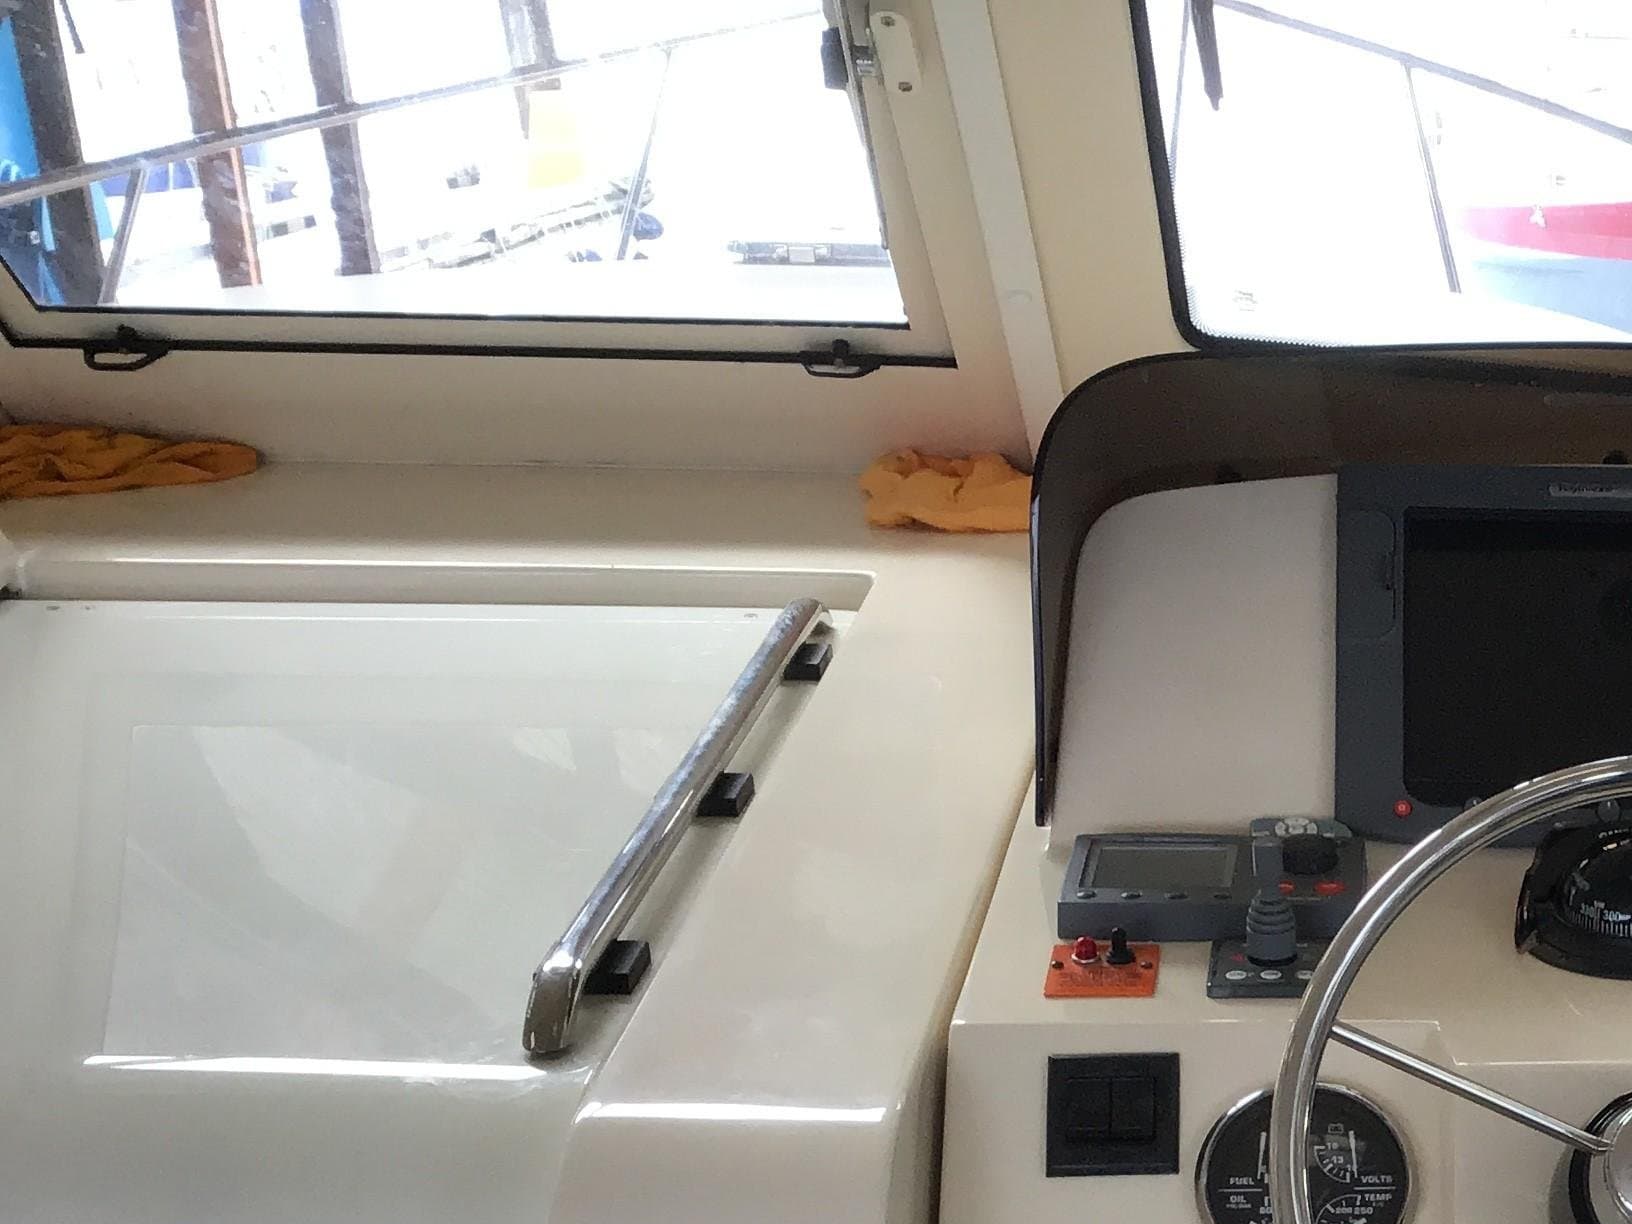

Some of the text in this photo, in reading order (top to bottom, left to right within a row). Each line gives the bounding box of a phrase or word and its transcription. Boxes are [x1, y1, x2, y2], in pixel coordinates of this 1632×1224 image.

[1229, 1177, 1255, 1185] FUEL
[1360, 1175, 1393, 1184] VOLTS
[1230, 1195, 1247, 1203] OIL
[1364, 1193, 1393, 1201] TEMP
